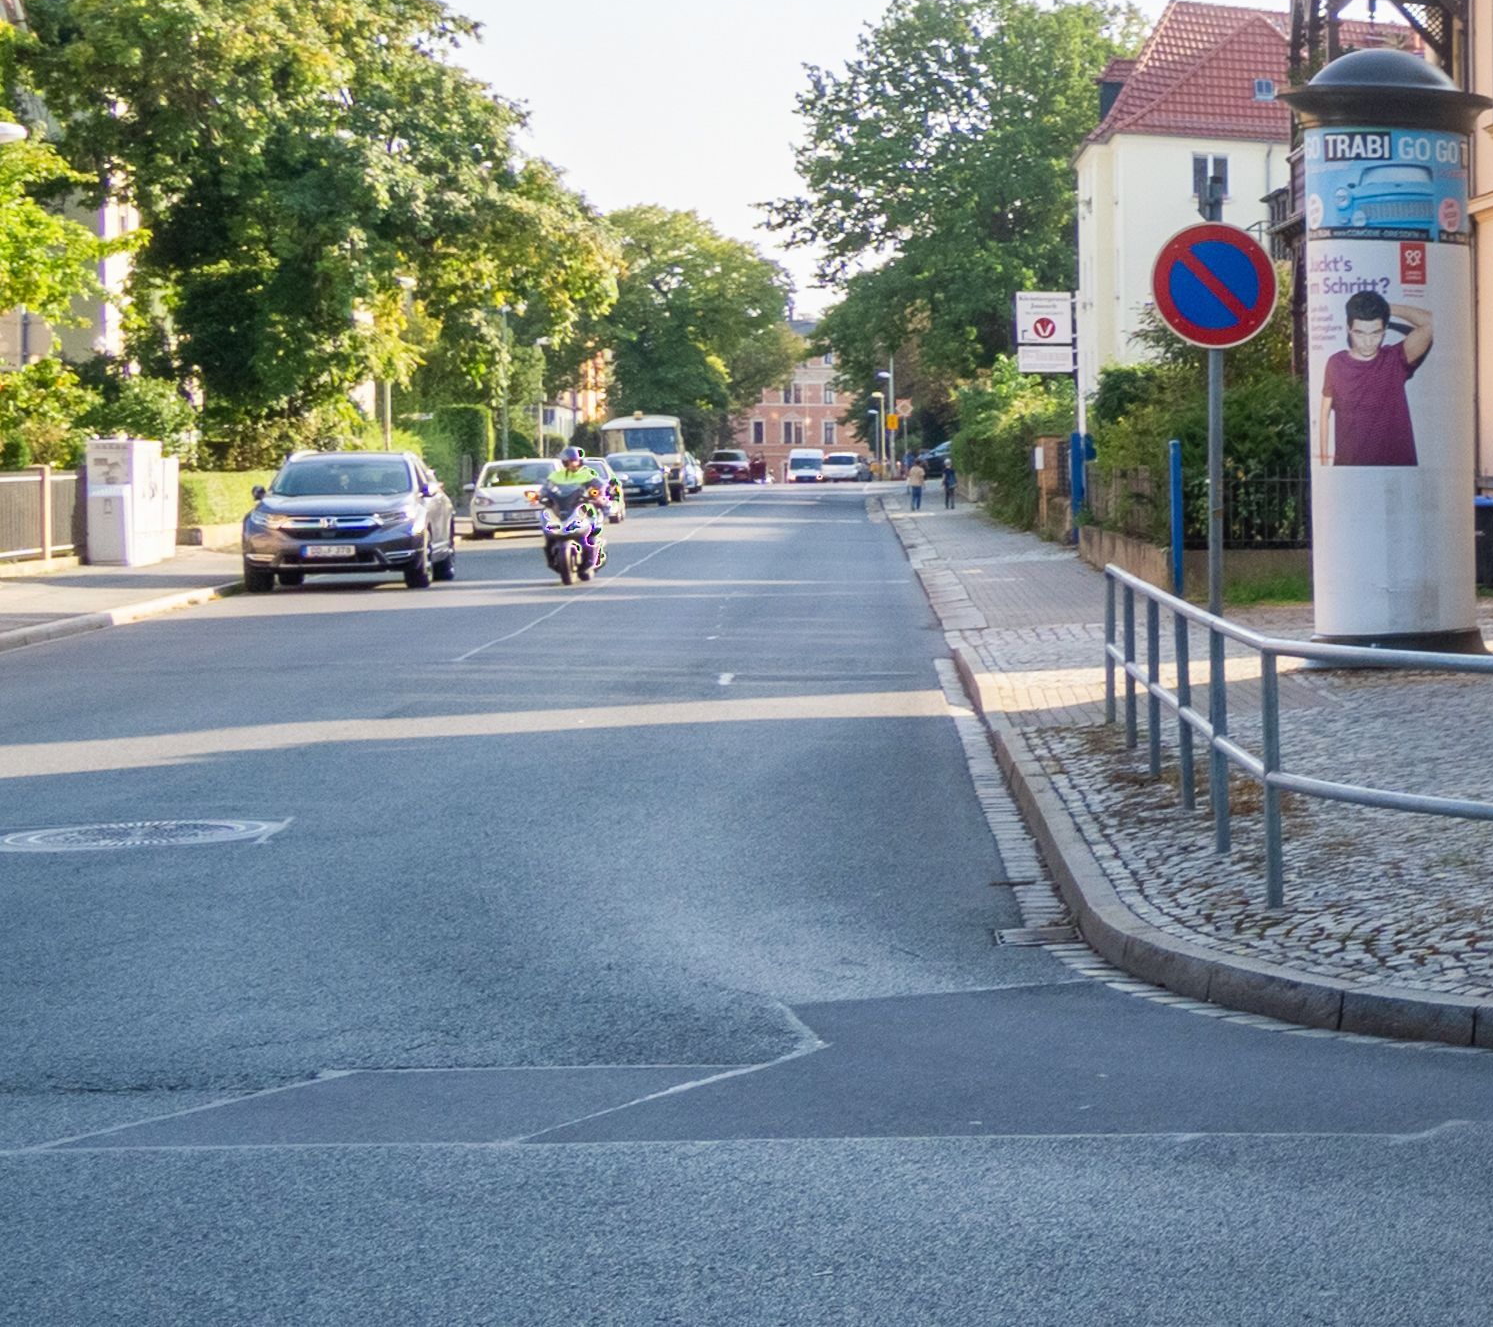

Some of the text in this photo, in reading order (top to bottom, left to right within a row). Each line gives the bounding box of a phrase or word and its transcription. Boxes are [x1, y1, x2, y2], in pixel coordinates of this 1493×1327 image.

[1325, 134, 1390, 159] TRABI
[1399, 136, 1431, 161] GO
[1435, 139, 1459, 164] GO
[1323, 275, 1391, 294] Schritt?
